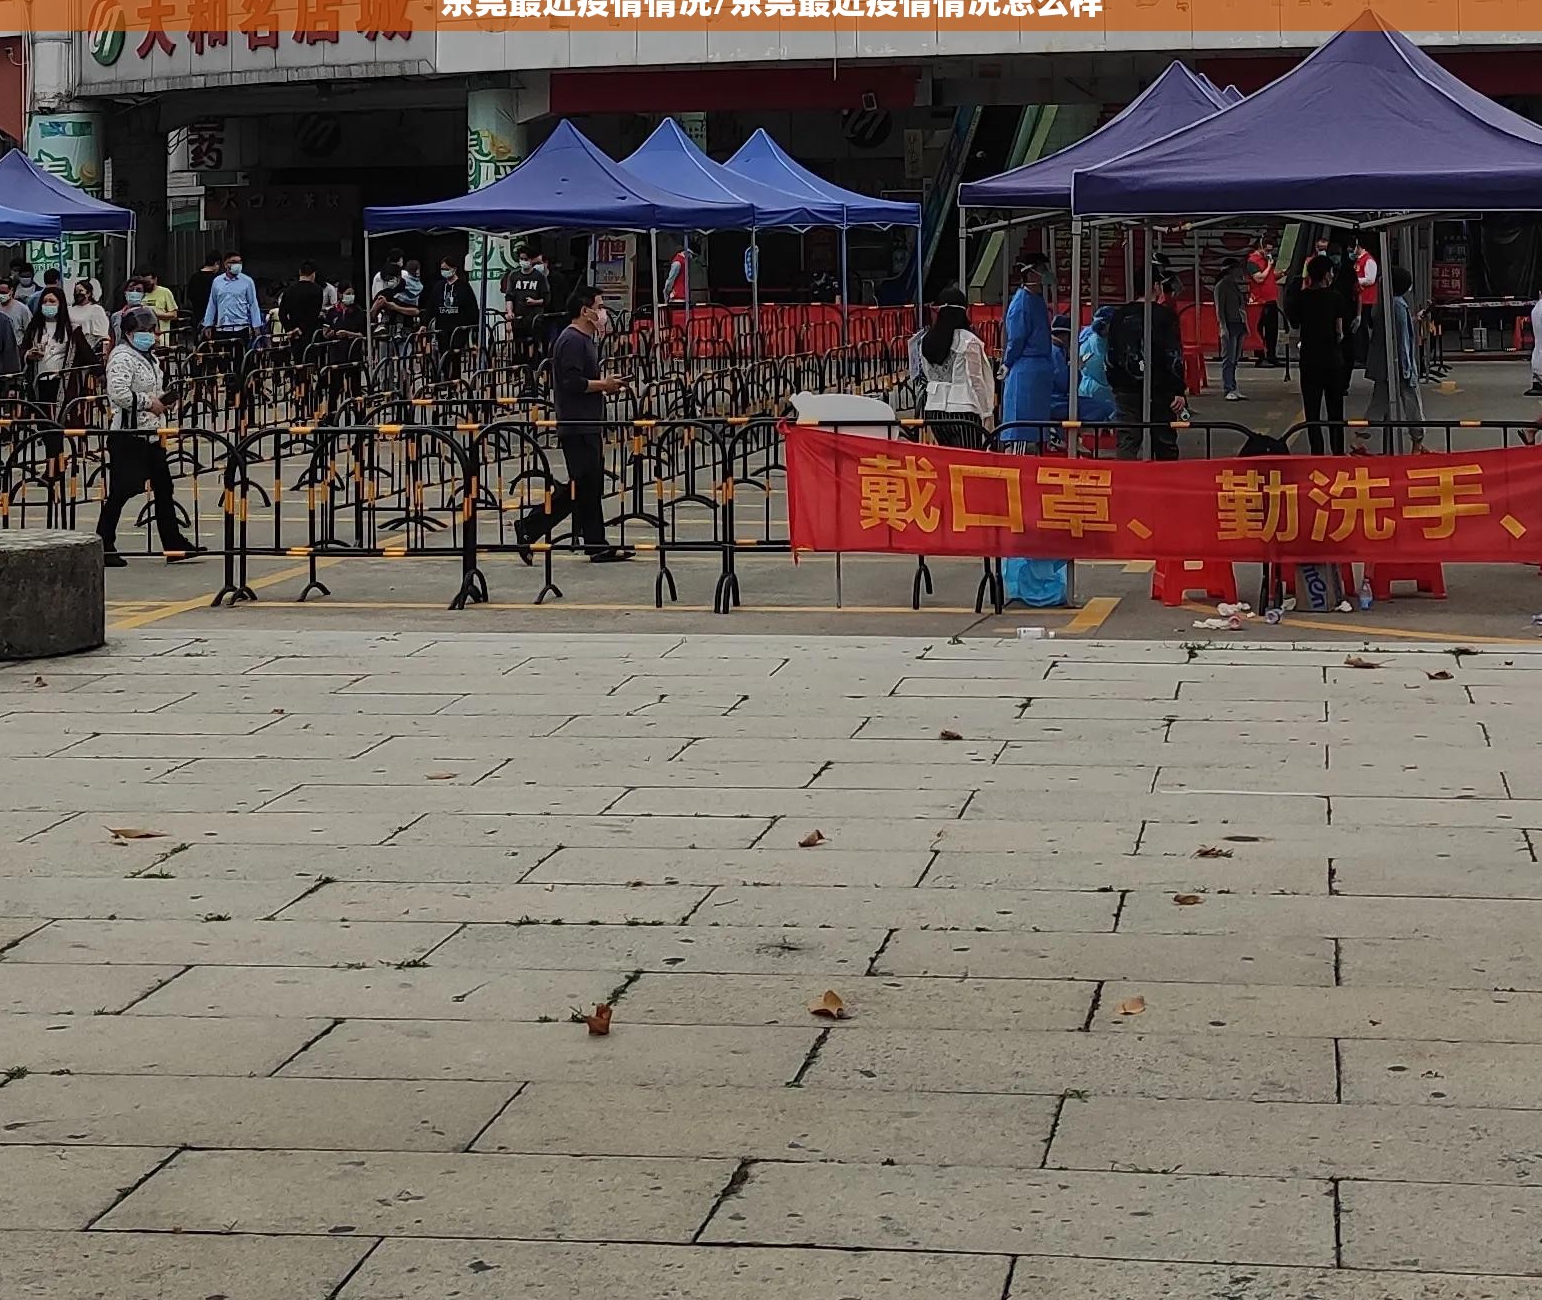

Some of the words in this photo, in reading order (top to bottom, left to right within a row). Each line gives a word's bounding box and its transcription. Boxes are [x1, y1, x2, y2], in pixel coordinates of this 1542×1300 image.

[857, 454, 1154, 541] 戴口罩、
[1215, 463, 1527, 543] 勤洗手、
